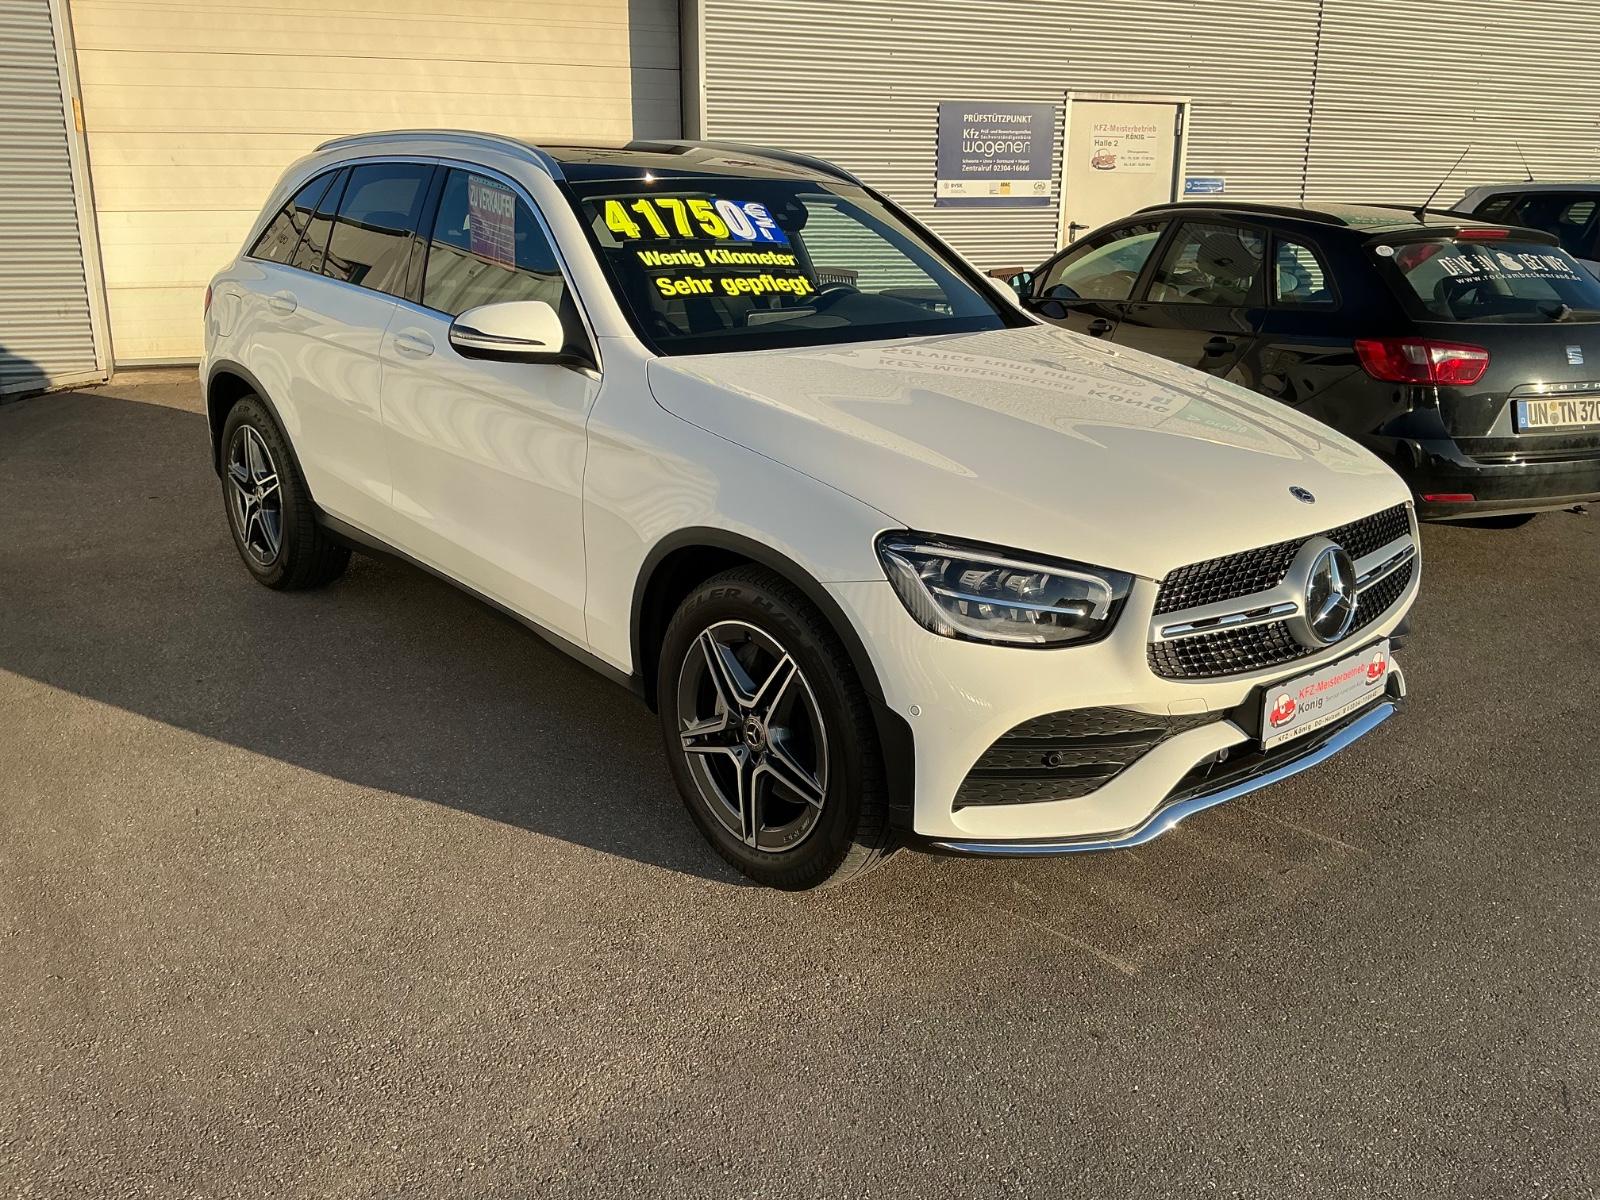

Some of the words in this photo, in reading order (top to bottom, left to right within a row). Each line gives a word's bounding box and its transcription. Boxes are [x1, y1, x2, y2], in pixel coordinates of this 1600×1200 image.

[963, 113, 1032, 123] PRÜFSTÜTZPUNKT
[963, 128, 979, 139] Kfz
[1093, 124, 1157, 133] KFZ-Meisterbetrieb
[963, 141, 1030, 157] wagener
[1094, 139, 1112, 147] Halle
[961, 164, 992, 172] Zentralruf
[637, 250, 705, 267] Wenig
[704, 250, 796, 266] Kilometer
[1471, 254, 1500, 272] IN
[656, 277, 713, 296] Sehr
[720, 275, 814, 296] gepflegt
[1528, 402, 1549, 425] UN
[1558, 401, 1578, 423] TN
[1298, 664, 1365, 698] KFZ-Meisterbetrieb
[1298, 698, 1324, 714] König
